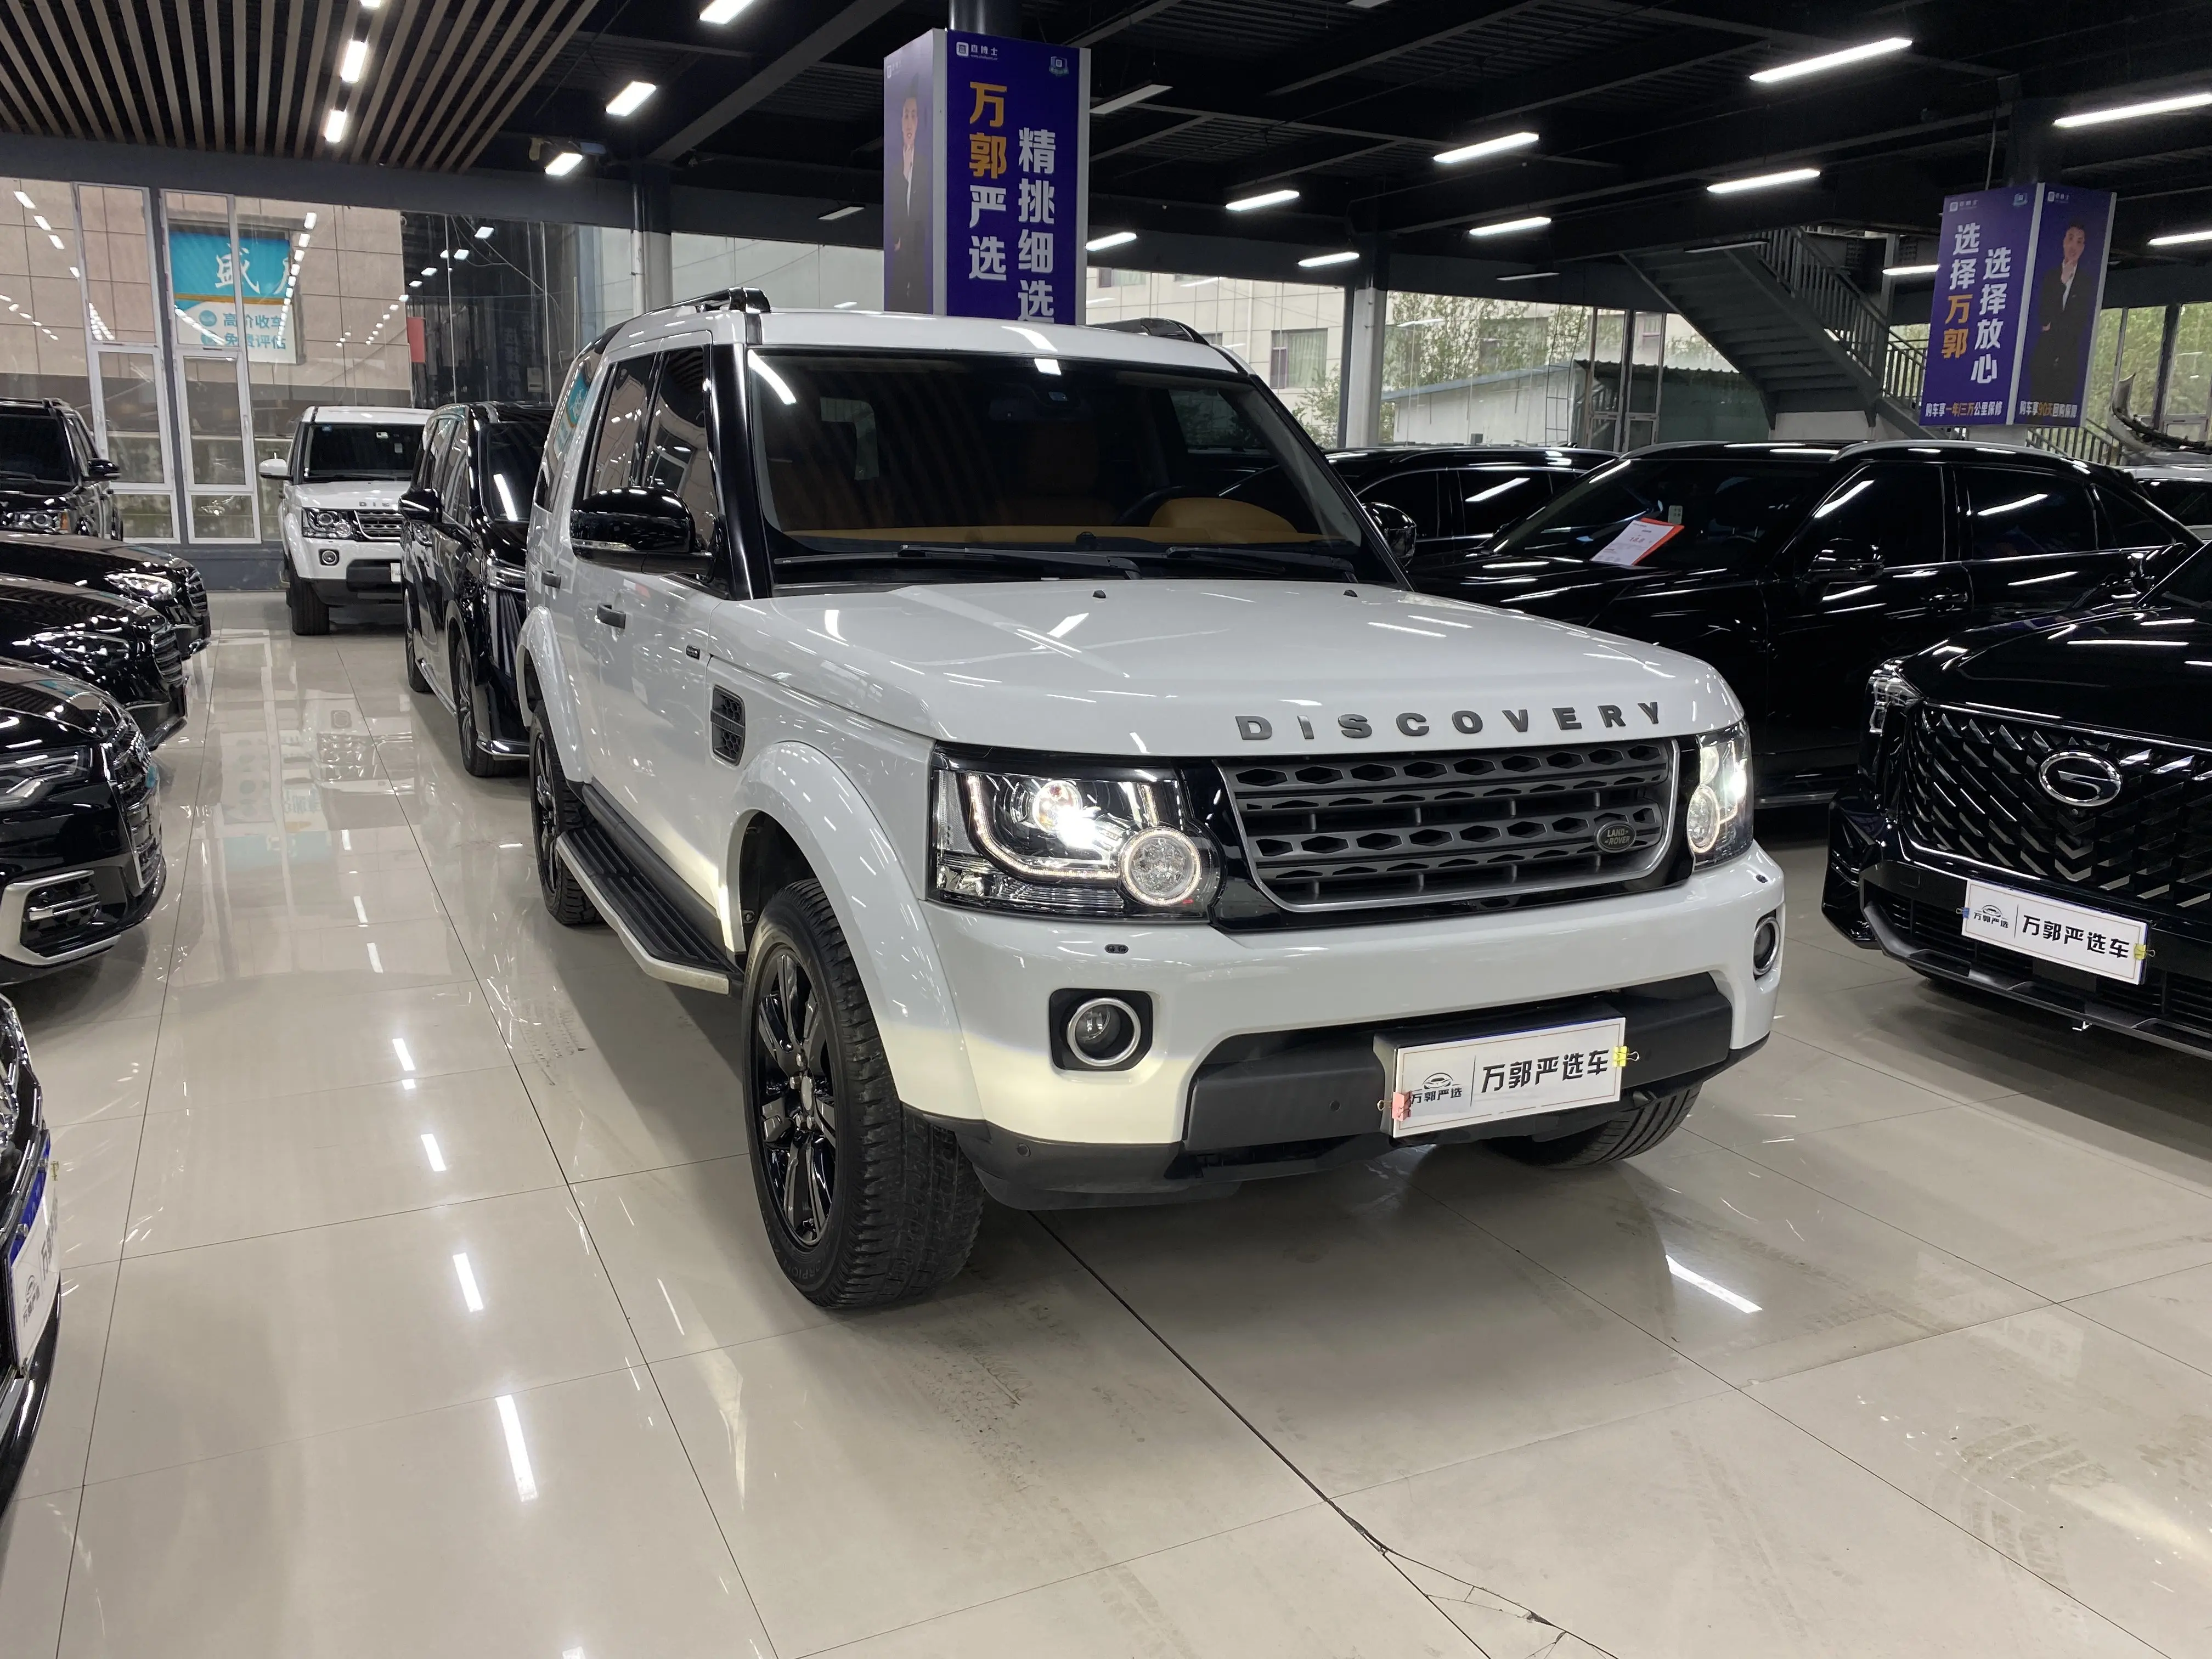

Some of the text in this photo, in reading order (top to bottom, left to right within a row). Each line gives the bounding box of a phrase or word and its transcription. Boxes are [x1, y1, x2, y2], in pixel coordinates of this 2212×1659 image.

[969, 81, 1007, 281] 万郭严选
[1018, 127, 1056, 323] 精挑细选
[1941, 222, 1981, 359] 选择万郭
[1970, 247, 2012, 385] 选择放心
[1235, 702, 1660, 740] DISCOVERY
[1607, 828, 1625, 837] LAND
[1608, 836, 1630, 845] ROVER
[1973, 912, 2008, 928] 万郭严选
[2022, 915, 2130, 958] 万郭严选车
[1481, 1049, 1610, 1093] 万郭严选车
[1411, 1087, 1462, 1104] 万郭严选
